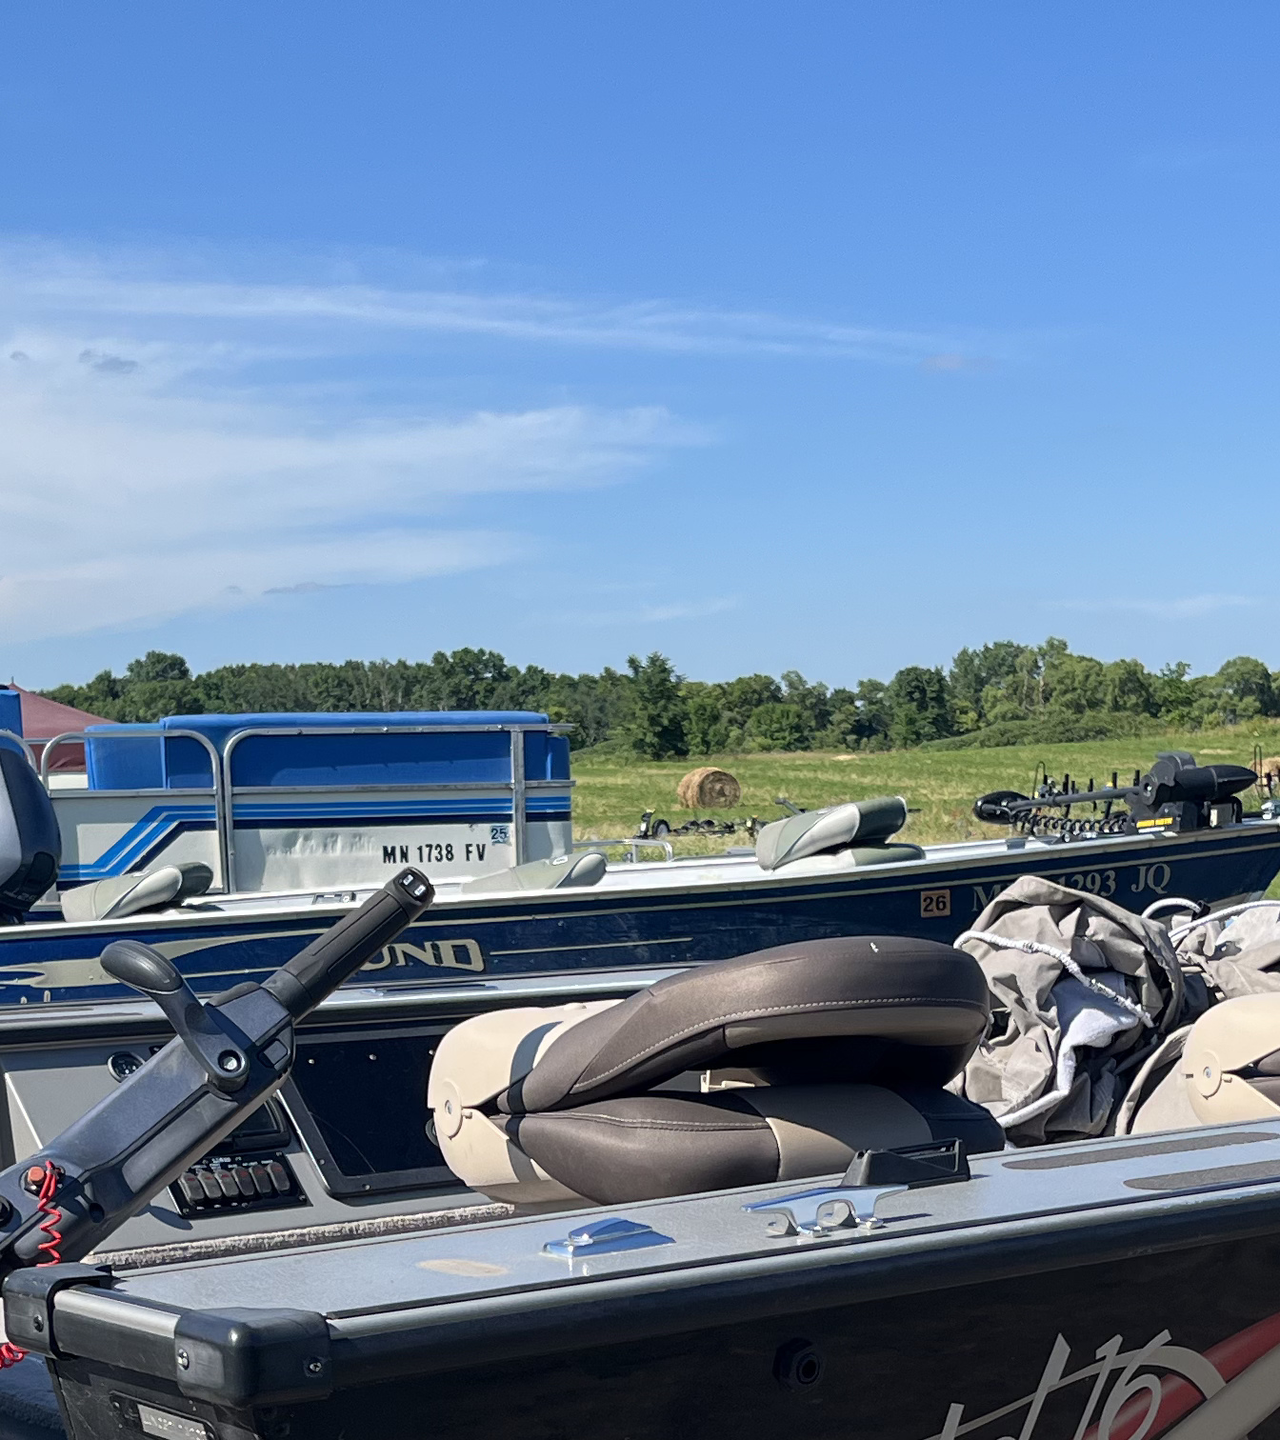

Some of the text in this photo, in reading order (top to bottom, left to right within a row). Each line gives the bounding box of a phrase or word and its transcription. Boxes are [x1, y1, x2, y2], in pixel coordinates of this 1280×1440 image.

[490, 827, 508, 841] 25
[382, 843, 487, 864] MN 1738 FV
[971, 884, 1002, 912] M
[1130, 863, 1171, 895] JQ
[922, 895, 947, 913] 26
[359, 938, 486, 973] UND
